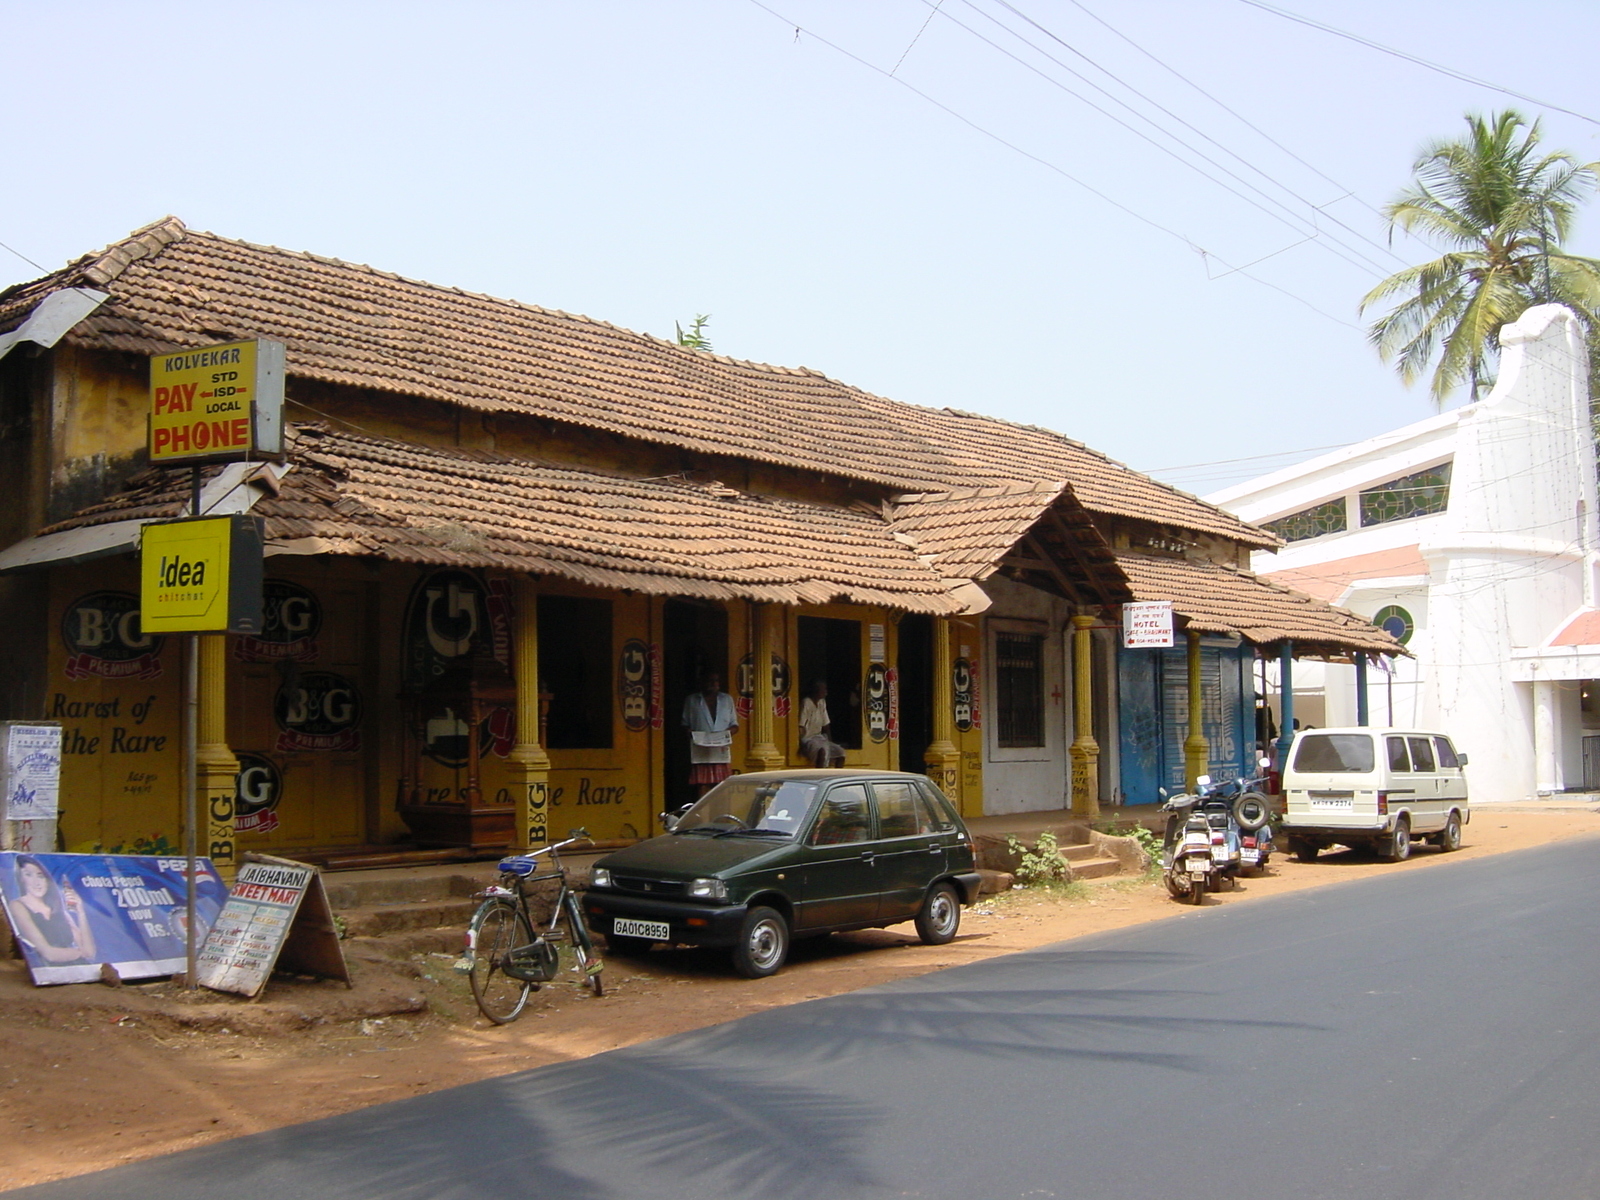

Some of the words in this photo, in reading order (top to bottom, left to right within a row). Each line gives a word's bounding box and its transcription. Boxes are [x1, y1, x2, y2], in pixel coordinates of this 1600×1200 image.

[165, 348, 241, 372] KOLVEKAR
[211, 371, 238, 383] STD
[155, 382, 199, 416] PAY
[213, 386, 236, 398] ISD
[206, 401, 241, 414] LOCAL
[154, 418, 249, 454] PHONE
[158, 592, 204, 602] chitchat
[624, 650, 645, 720] B&G
[954, 667, 970, 723] B&G
[131, 695, 156, 725] of
[286, 688, 353, 723] B&G
[870, 671, 886, 731] B&G
[62, 728, 100, 755] the
[110, 727, 167, 754] Rare
[576, 777, 627, 805] Rare
[210, 794, 235, 861] B&G
[529, 782, 547, 845] B&G
[82, 876, 113, 888] chota
[114, 876, 145, 888] Pepsi
[231, 883, 269, 901] SWEET
[269, 888, 301, 905] MART
[112, 887, 175, 908] 200ml
[128, 909, 153, 921] now
[144, 922, 171, 938] Rs.
[615, 921, 668, 938] GA01C8959
